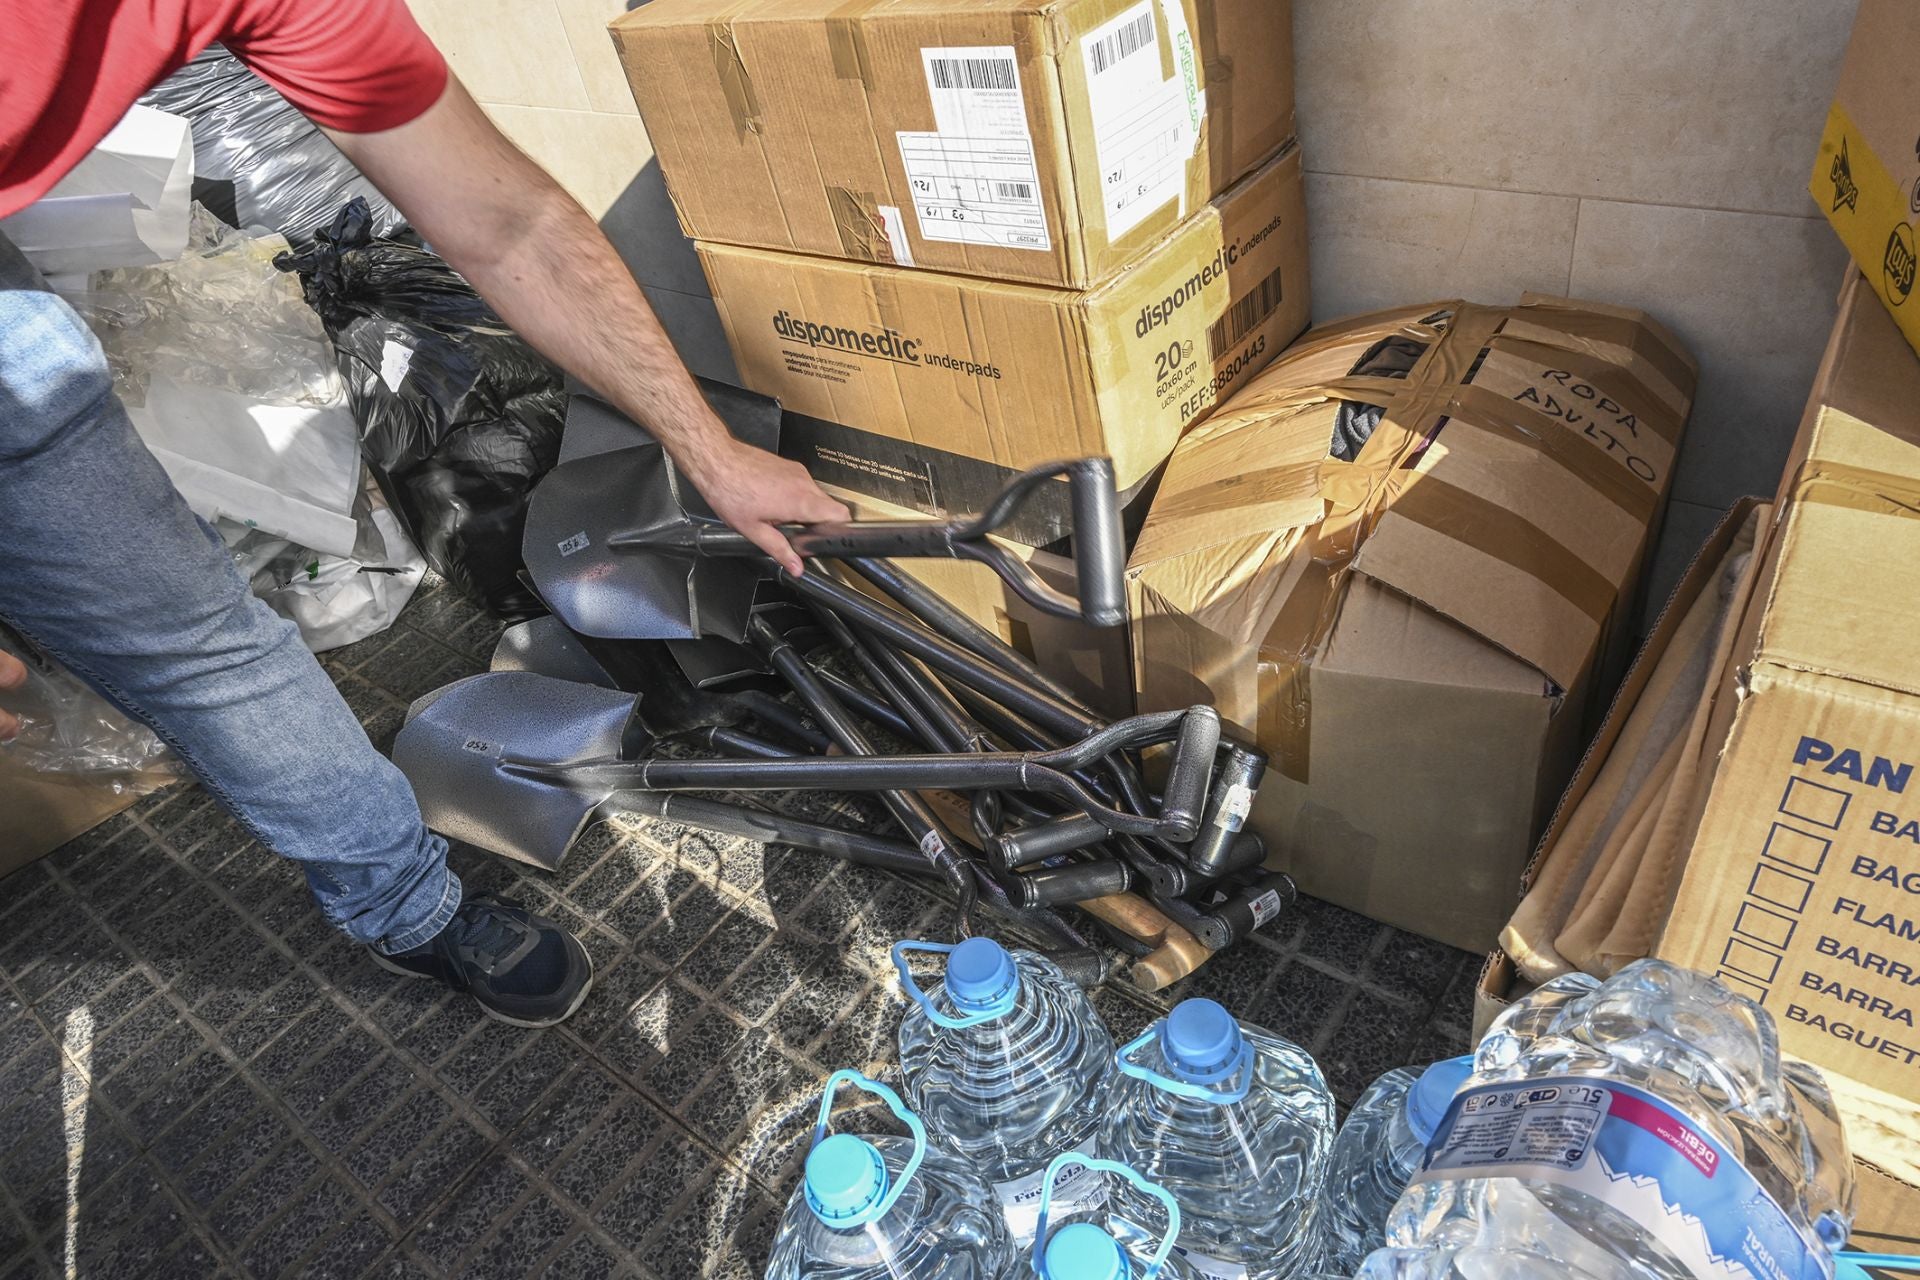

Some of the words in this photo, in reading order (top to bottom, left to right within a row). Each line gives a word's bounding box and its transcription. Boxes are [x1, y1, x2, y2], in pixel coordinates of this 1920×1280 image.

[1240, 215, 1282, 257] underpads
[924, 353, 1002, 379] underpads
[1154, 341, 1182, 382] 20
[1156, 371, 1183, 398] 60x60
[1184, 361, 1198, 376] cm
[1180, 334, 1266, 422] REF:8880443
[1542, 369, 1638, 439] ROPA
[1792, 735, 1914, 794] PAN
[1800, 971, 1913, 1027] BARRA
[1785, 1003, 1920, 1068] BAGUET
[1679, 1126, 1716, 1164] DÉBIL
